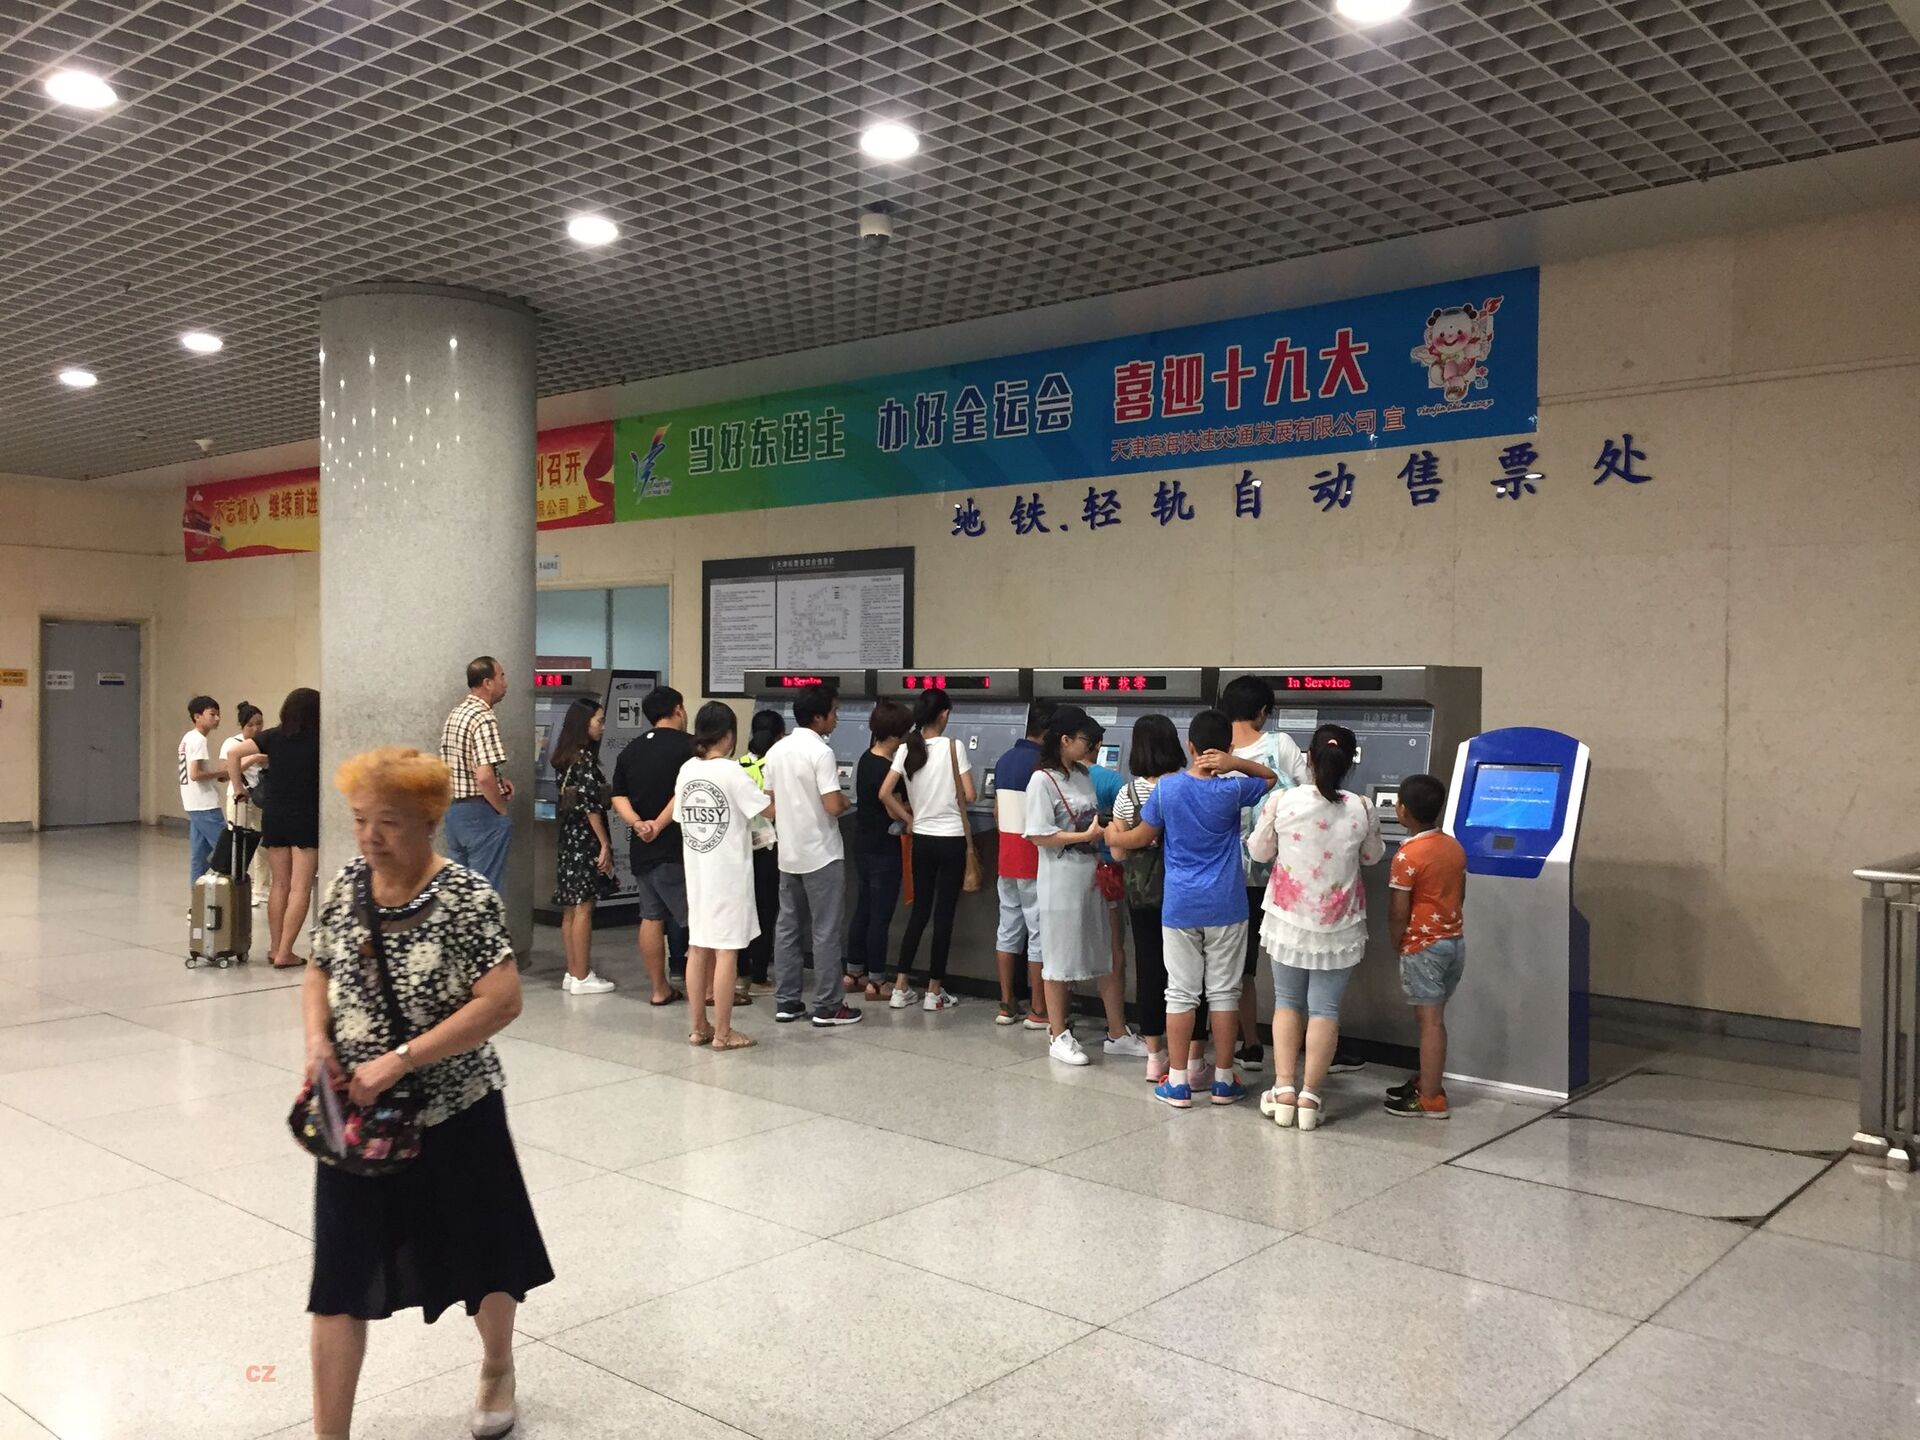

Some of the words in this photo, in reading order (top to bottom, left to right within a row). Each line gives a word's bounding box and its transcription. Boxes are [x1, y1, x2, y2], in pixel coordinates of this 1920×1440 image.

[688, 406, 846, 476] 当好东道主
[876, 371, 1074, 452] 办好全运会
[1113, 327, 1370, 424] 喜迎十九大
[1111, 408, 1377, 461] 天津滨海快速交通发展有限公司
[1382, 405, 1406, 433] 宣
[1287, 677, 1300, 688] In
[1304, 677, 1351, 688] Service
